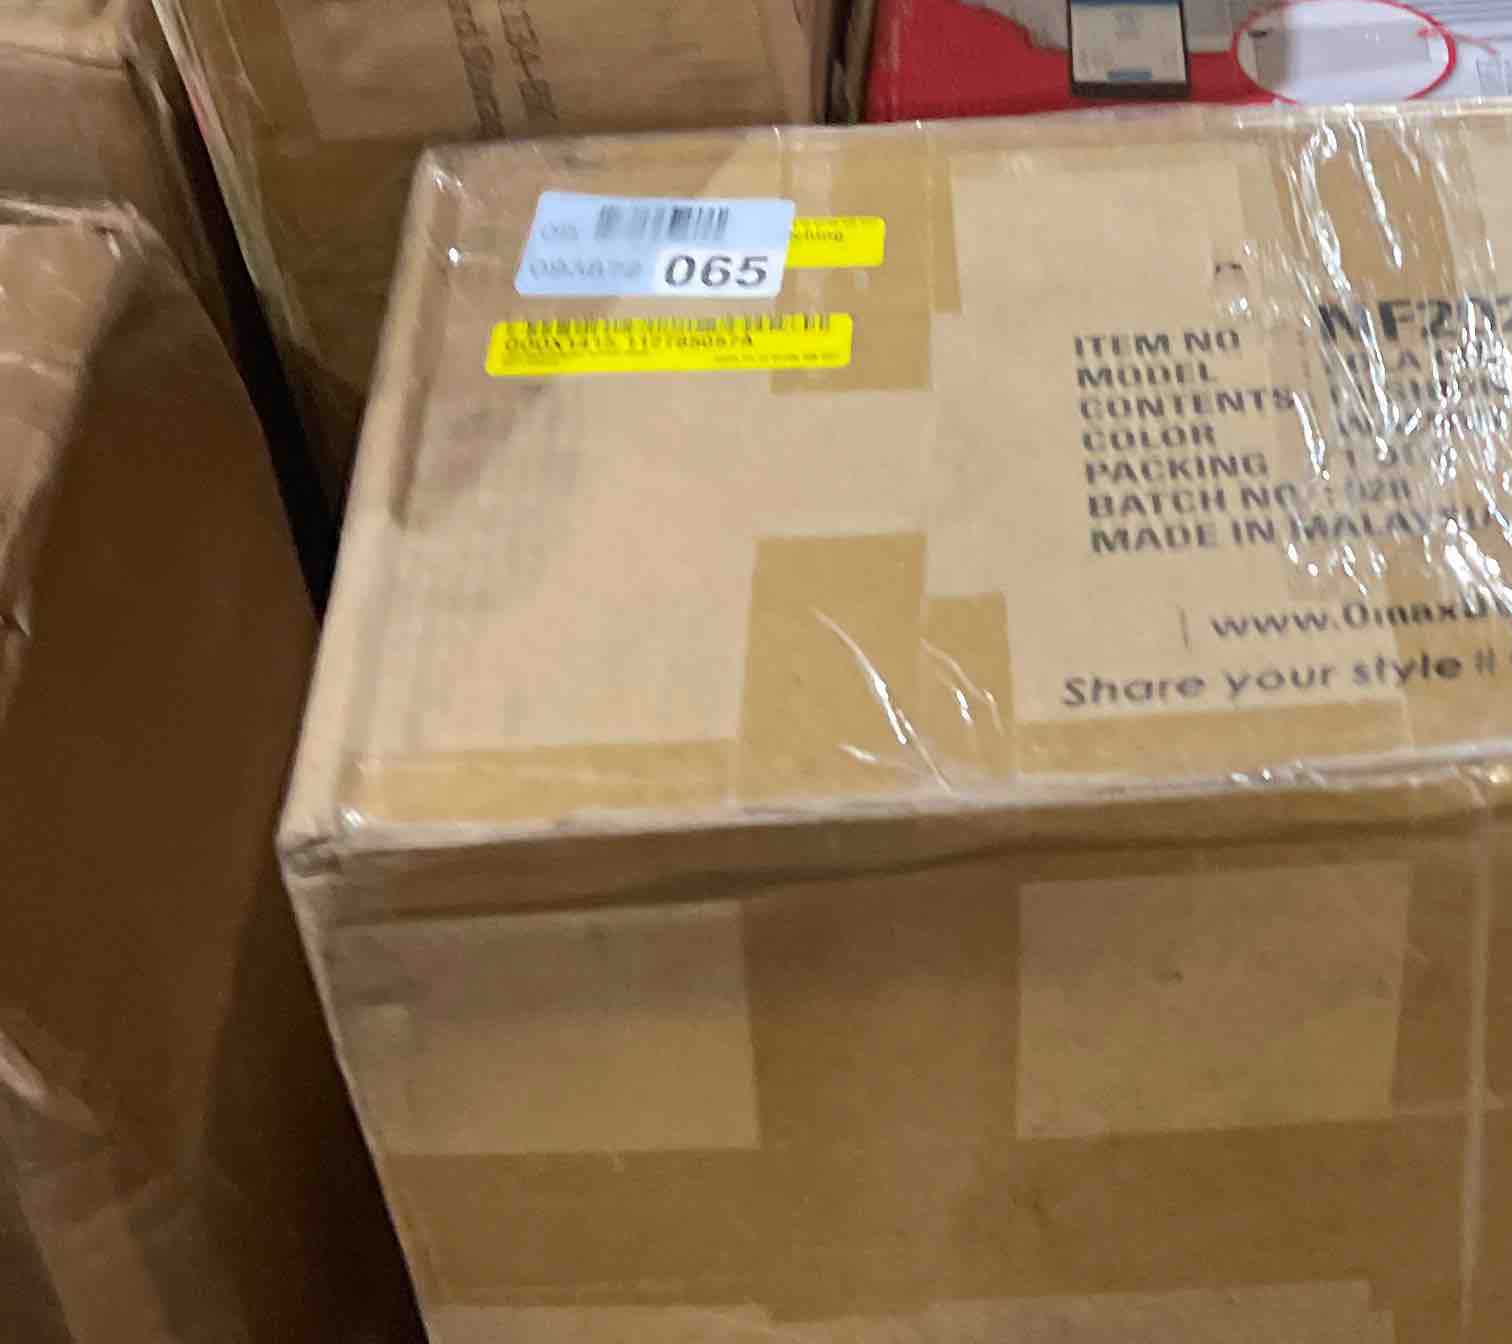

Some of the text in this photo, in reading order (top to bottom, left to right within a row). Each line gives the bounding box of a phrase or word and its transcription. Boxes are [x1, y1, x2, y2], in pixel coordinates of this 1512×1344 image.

[664, 255, 769, 289] 065
[1074, 331, 1171, 357] ITEM
[1182, 327, 1241, 355] NO
[1076, 361, 1217, 388] MODEL
[1079, 386, 1297, 420] CONTENTS
[1082, 423, 1217, 453] COLOR
[1085, 452, 1269, 485] PACKING
[1088, 487, 1228, 519] BATCH
[1090, 524, 1217, 554] MADE
[1230, 519, 1277, 546] IN
[1063, 672, 1206, 708] Share
[1224, 663, 1335, 701] your
[1351, 650, 1463, 688] style
